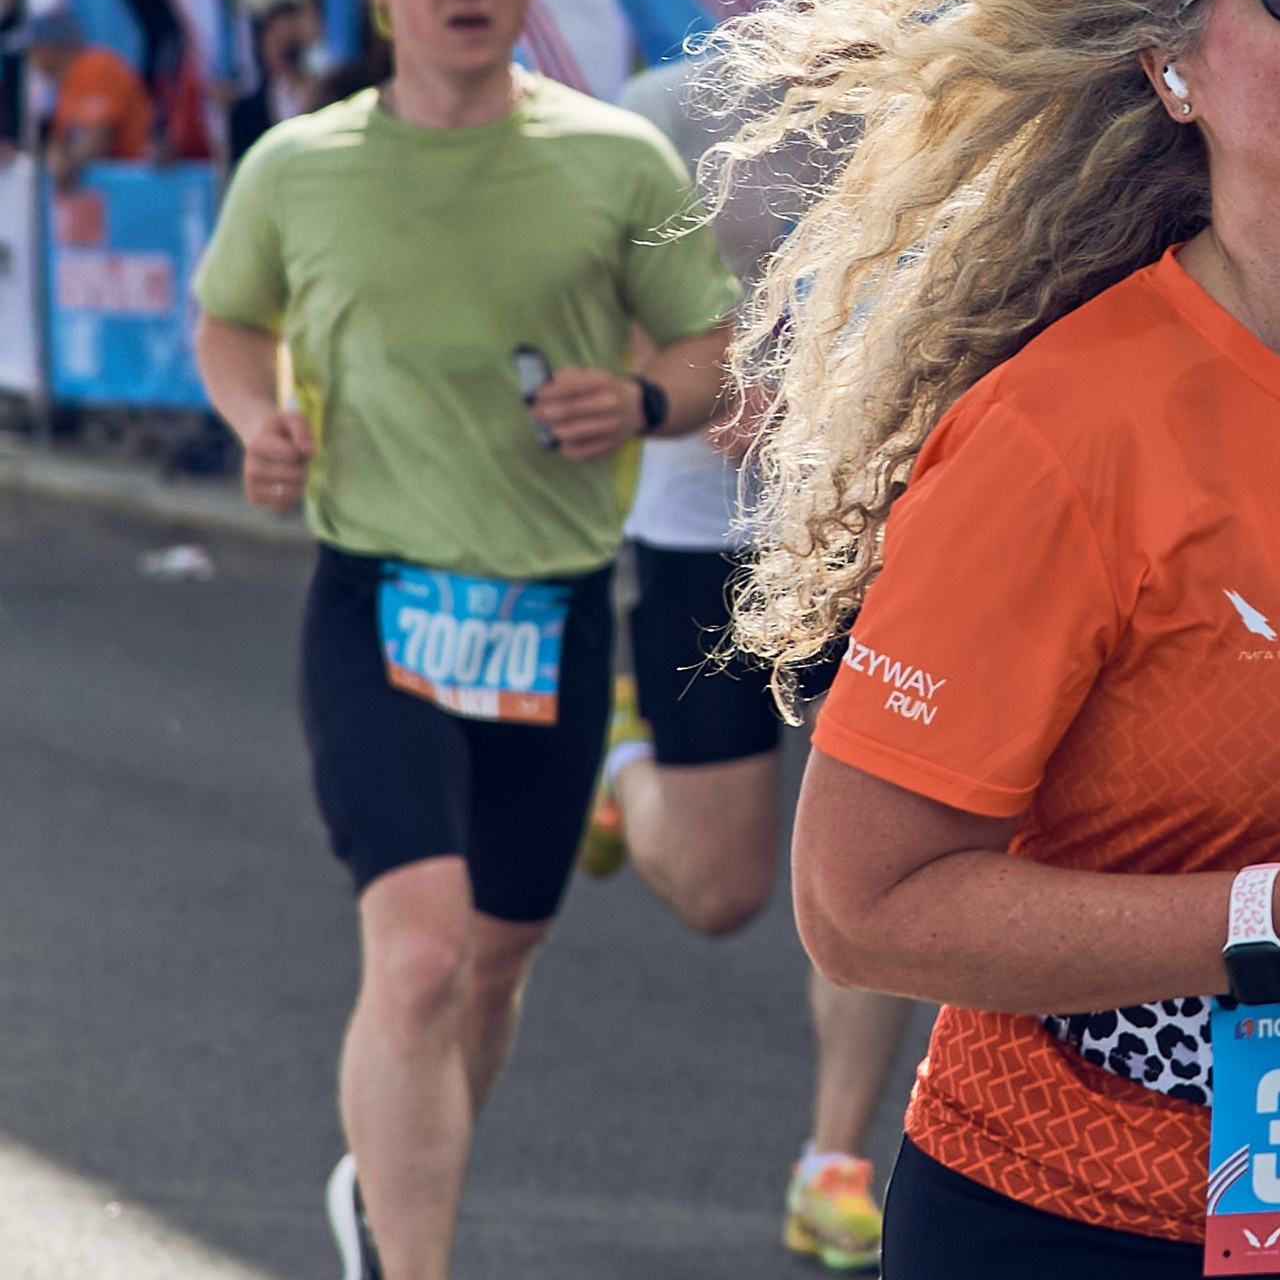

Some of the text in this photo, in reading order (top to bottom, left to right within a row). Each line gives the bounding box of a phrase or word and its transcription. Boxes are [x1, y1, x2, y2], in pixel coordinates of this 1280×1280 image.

[398, 606, 540, 690] 70070
[1238, 650, 1274, 662] ЛИГА
[884, 690, 938, 726] RUN
